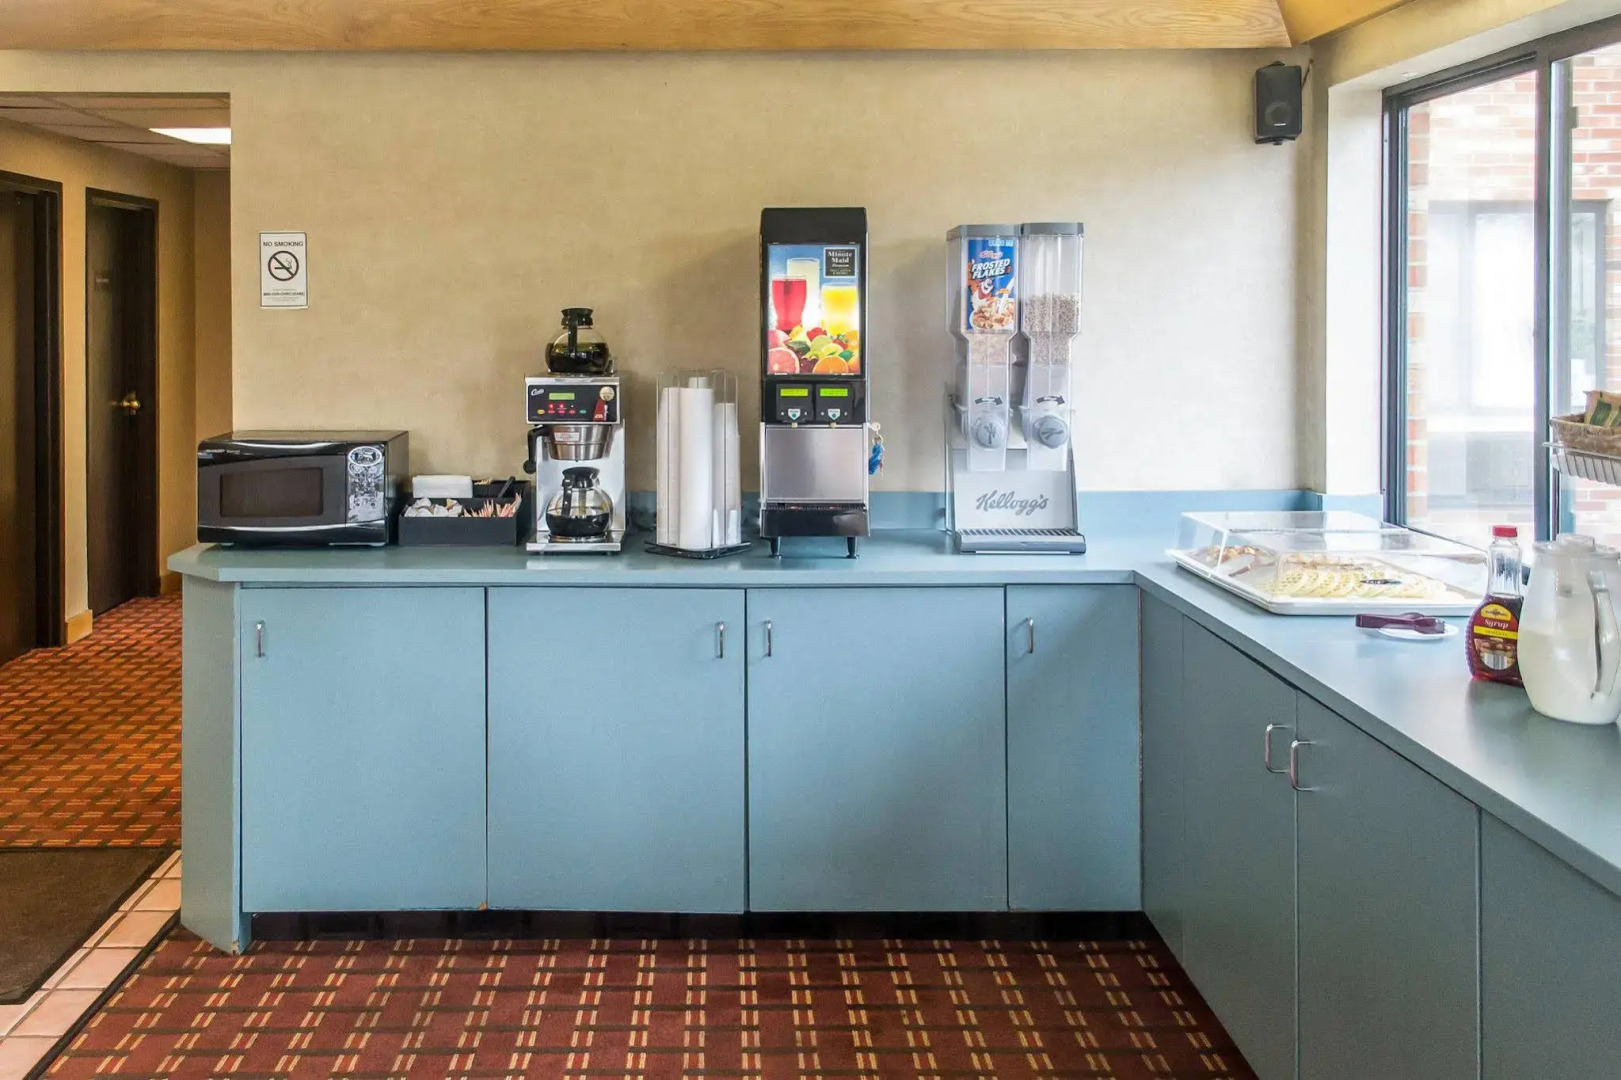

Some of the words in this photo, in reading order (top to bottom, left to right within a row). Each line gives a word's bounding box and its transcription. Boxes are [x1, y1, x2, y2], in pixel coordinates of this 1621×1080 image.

[971, 258, 1011, 273] FROSTED
[972, 266, 1006, 280] FLAKES
[975, 489, 1050, 516] Kellogg's
[1484, 618, 1509, 630] Syrup
